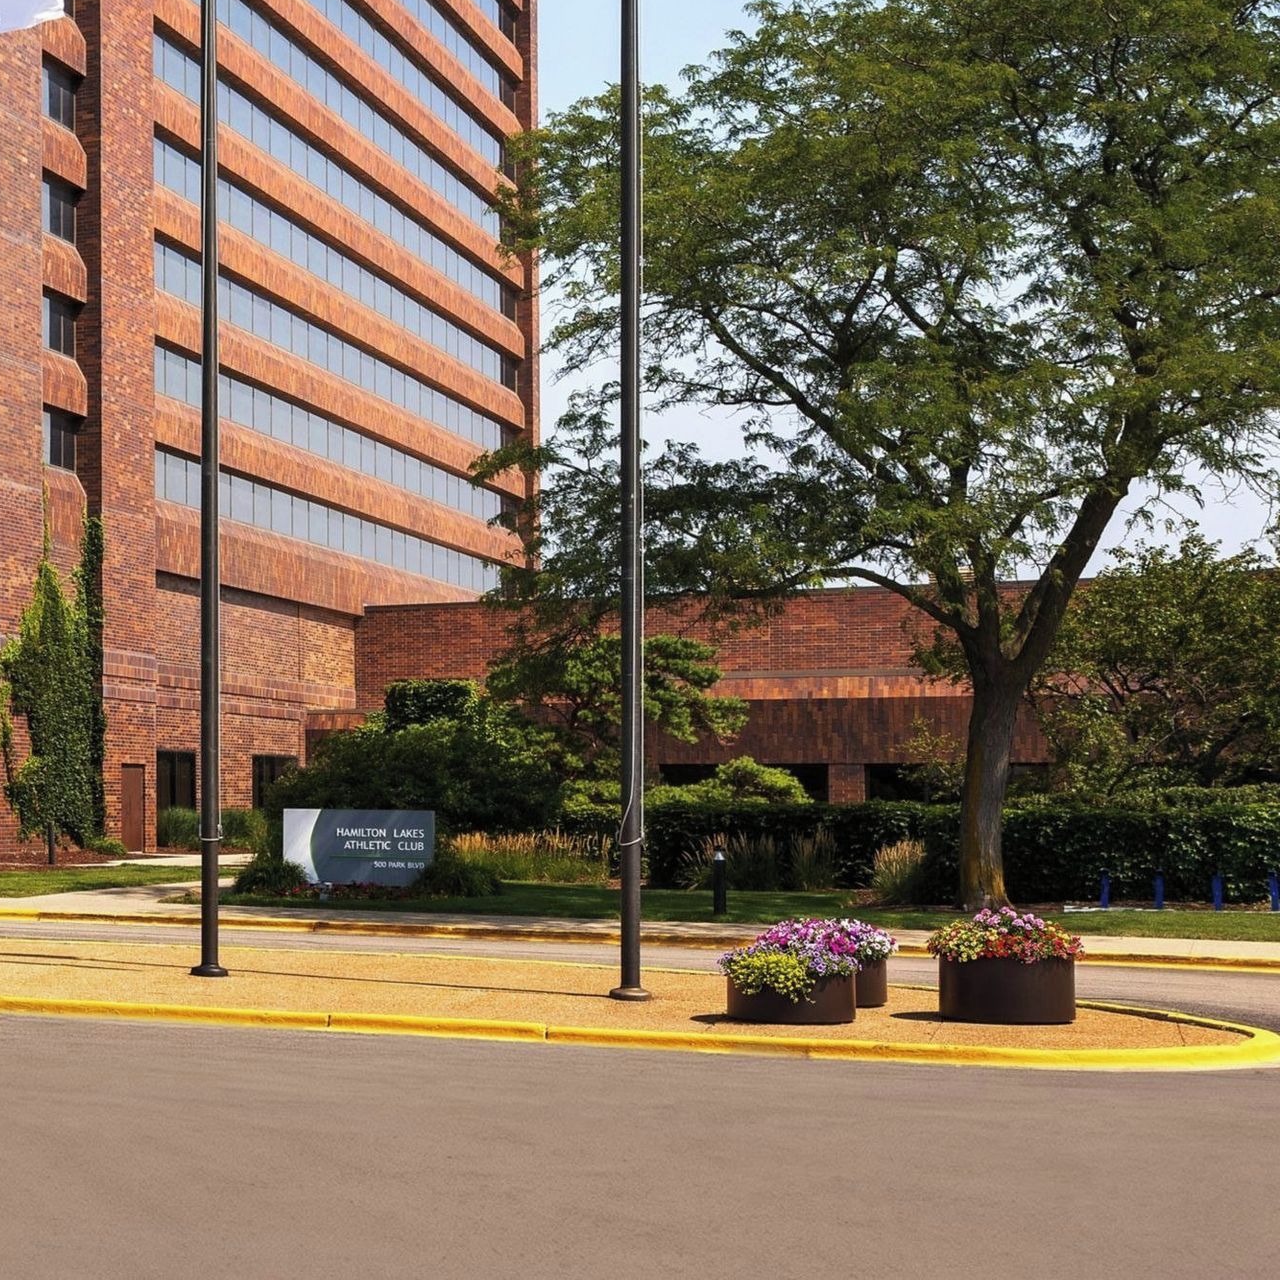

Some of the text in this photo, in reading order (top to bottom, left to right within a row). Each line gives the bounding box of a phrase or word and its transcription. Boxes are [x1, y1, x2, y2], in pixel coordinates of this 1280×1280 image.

[336, 827, 425, 839] HAMILTON LAKES
[344, 840, 425, 851] ATHLETIC CLUB
[373, 860, 425, 869] 500 PARK BLVD
